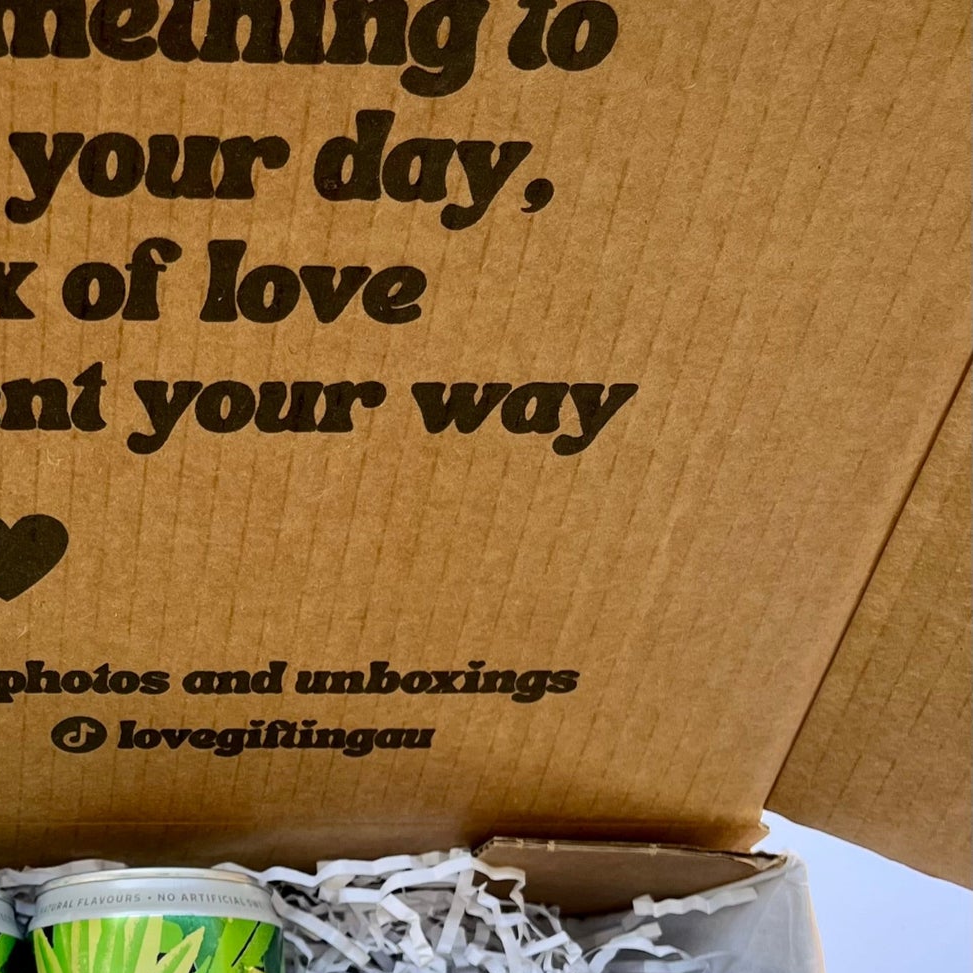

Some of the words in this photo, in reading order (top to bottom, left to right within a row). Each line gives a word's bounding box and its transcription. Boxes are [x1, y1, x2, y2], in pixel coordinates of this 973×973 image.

[507, 0, 619, 71] to
[4, 132, 291, 224] your
[313, 110, 554, 230] day,
[62, 238, 182, 321] of
[199, 239, 427, 323] love
[127, 380, 387, 455] your
[411, 382, 639, 456] way
[182, 661, 287, 695] and
[294, 661, 581, 703] unboxings
[117, 720, 436, 757] lovegiftingau
[77, 893, 141, 906] FLAVOURS
[157, 893, 176, 902] NO
[181, 893, 246, 906] ARTIFICIAL
